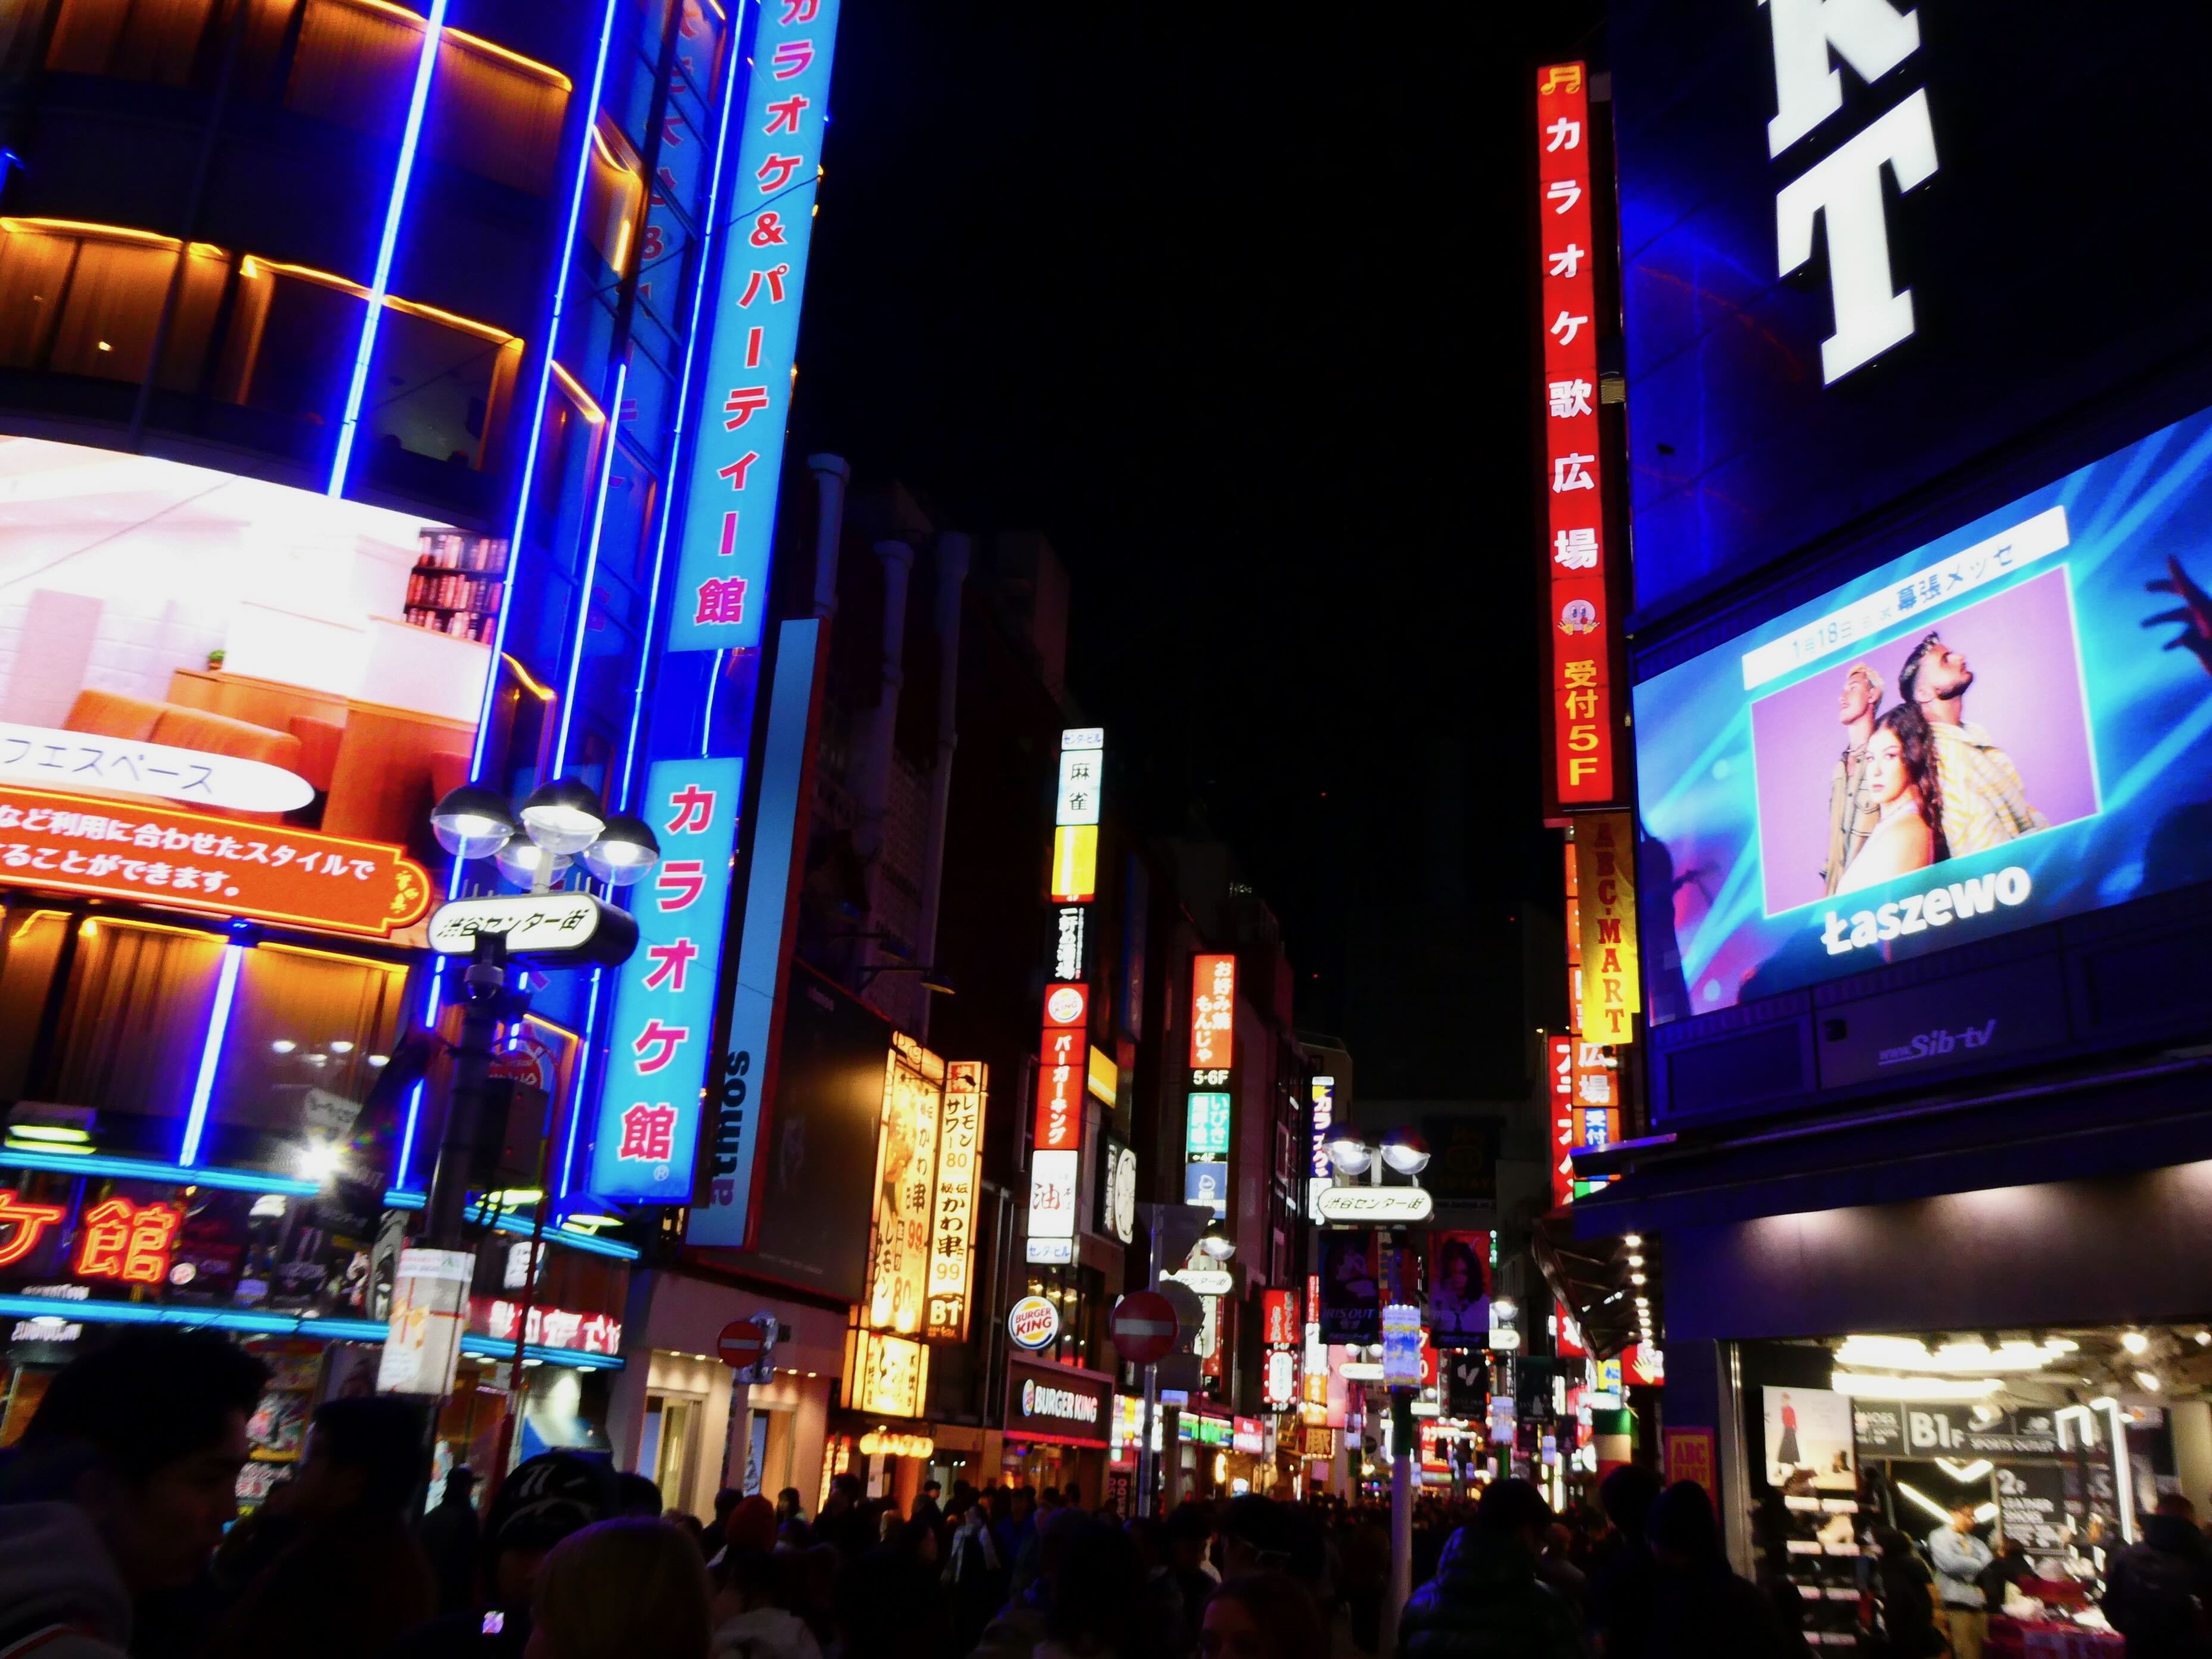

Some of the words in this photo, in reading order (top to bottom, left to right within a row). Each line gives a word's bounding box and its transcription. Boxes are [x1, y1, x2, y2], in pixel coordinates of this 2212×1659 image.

[1546, 117, 1599, 570] カラオケ歌広場
[1896, 543, 2016, 613] 幕張メッセ
[1069, 763, 1090, 810] 麻雀
[0, 843, 239, 897] ることができます。
[617, 784, 716, 1163] カラオケ館
[1194, 995, 1213, 1062] もんじゃ
[1048, 1035, 1072, 1145] バーガーキング
[710, 1050, 750, 1207] atmos
[1015, 1307, 1052, 1322] BURGER
[1015, 1316, 1052, 1337] KING
[1034, 1385, 1075, 1419] BURGER
[1074, 1394, 1098, 1423] KING
